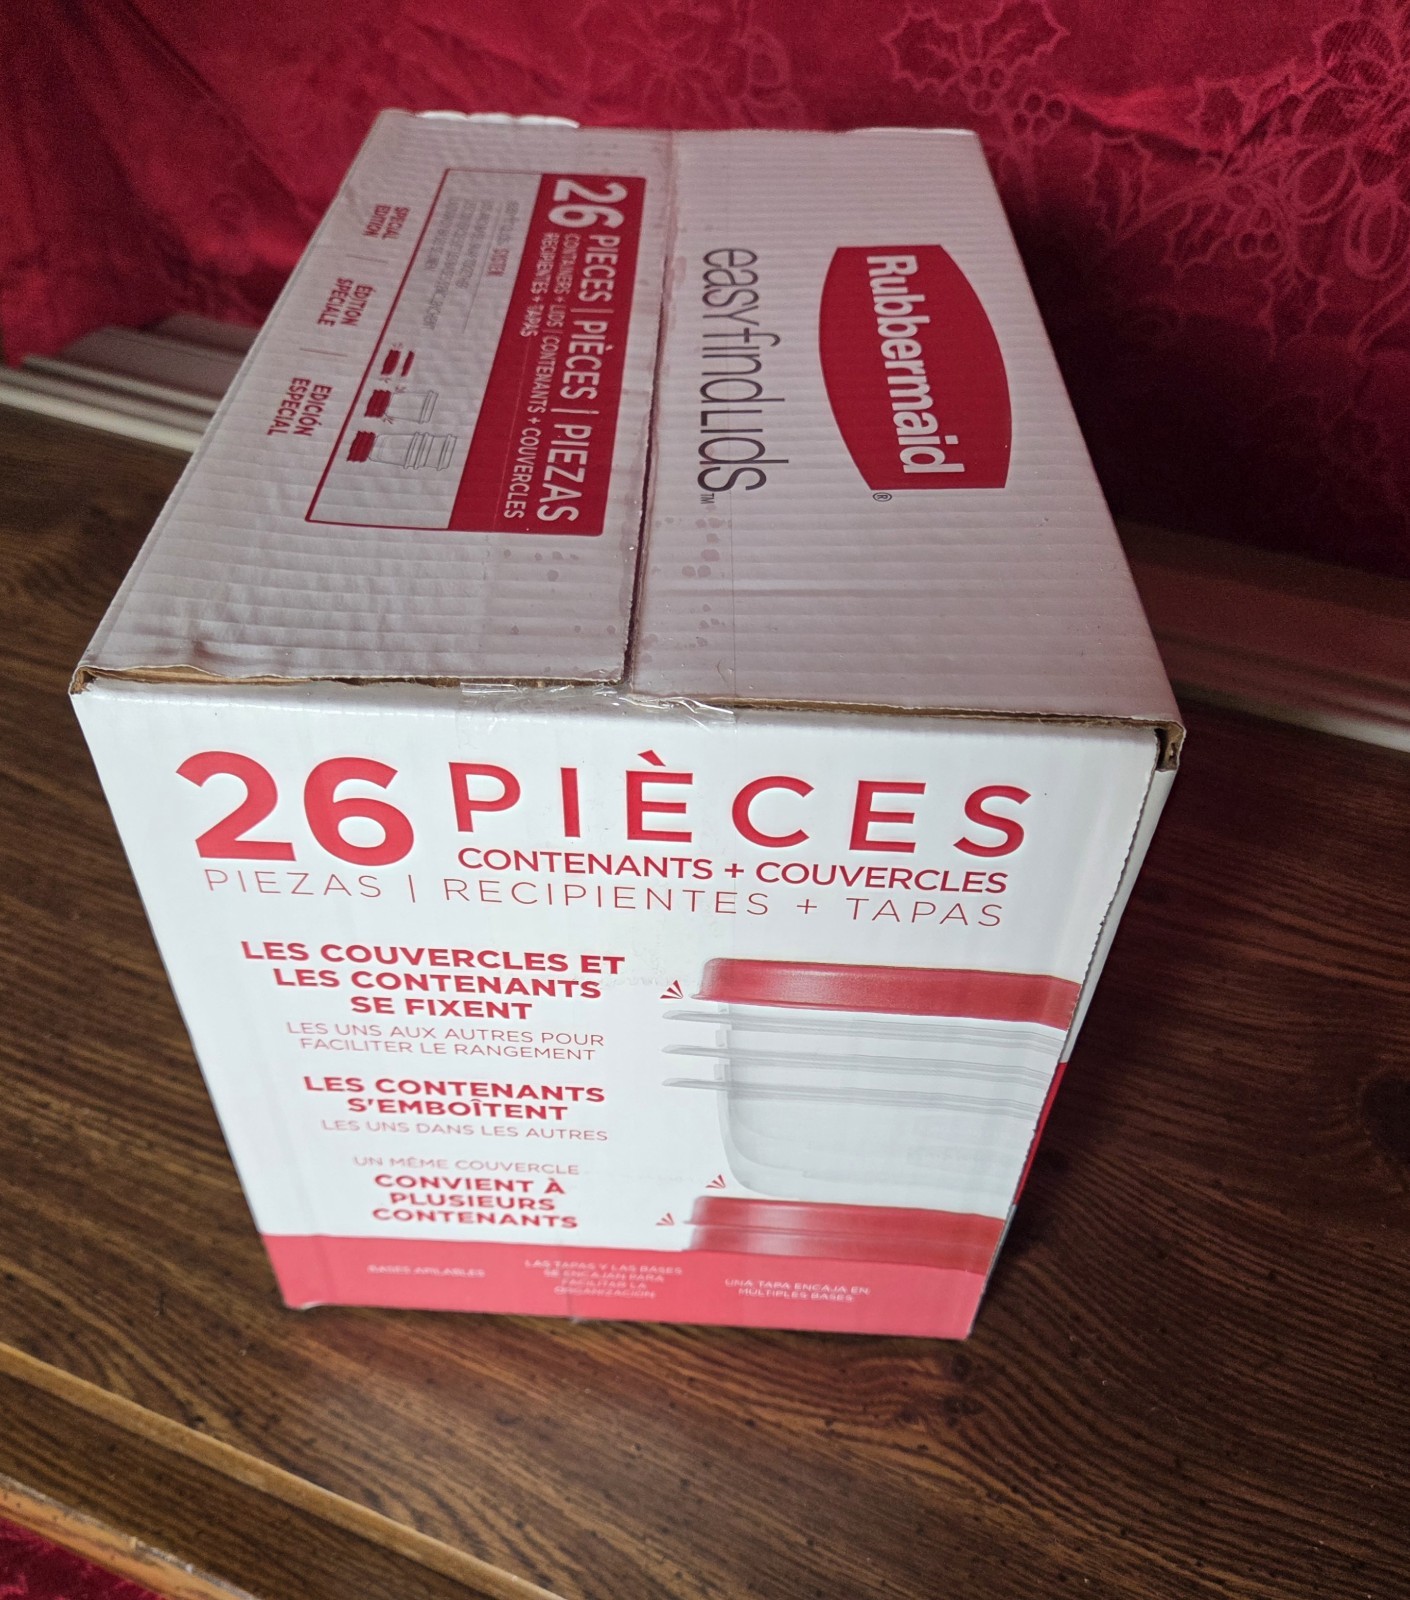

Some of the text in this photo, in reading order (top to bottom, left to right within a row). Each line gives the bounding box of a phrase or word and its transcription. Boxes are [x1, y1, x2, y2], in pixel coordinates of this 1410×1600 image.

[362, 203, 391, 238] EDITION
[382, 206, 410, 240] SPECIAL
[530, 232, 560, 294] RECIPIENTES
[553, 232, 581, 294] CONTAINERS
[317, 277, 354, 327] SPÉCIALE
[341, 283, 376, 326] ÉDITION
[546, 303, 566, 328] LIDS
[520, 303, 544, 337] TAPAS
[537, 179, 628, 522] 26 PIECES PIÈCES PIEZAS
[867, 255, 965, 473] Rubbermaid
[527, 335, 560, 414] CONTENANTS
[266, 377, 311, 436] ESPECIAL
[293, 383, 332, 437] EDICIÓN
[503, 427, 541, 519] COUVERCLES
[175, 749, 1032, 867] 26 PIÈCES
[457, 847, 713, 880] CONTENANTS
[755, 860, 1008, 894] COUVERCLES
[204, 868, 382, 898] PIEZAS
[444, 878, 769, 916] RECIPIENTES
[845, 897, 1003, 927] TAPAS
[241, 941, 625, 975] LES COUVERCLES ET
[273, 968, 602, 999] LES CONTENANTS
[350, 996, 533, 1020] SE FIXENT
[286, 1022, 604, 1047] LES UNS AUX AUTRES POUR
[300, 1038, 596, 1061] FACILITER LE RANGEMENT
[303, 1076, 605, 1103] LES CONTENANTS
[347, 1098, 568, 1121] S'EMBOÎTENT
[322, 1120, 608, 1141] LES UNS DANS LES AUTRES
[352, 1156, 580, 1176] UN MÊME COUVERCLE
[374, 1174, 565, 1195] CONVIENT À
[389, 1192, 555, 1211] PLUSIEURS
[372, 1208, 578, 1229] CONTENANTS
[555, 1260, 596, 1271] TAPAS
[611, 1264, 636, 1273] LAS
[639, 1265, 683, 1275] BASES
[725, 1278, 871, 1295] UNA TAPA ENCAJA EN
[811, 1293, 854, 1303] BASES
